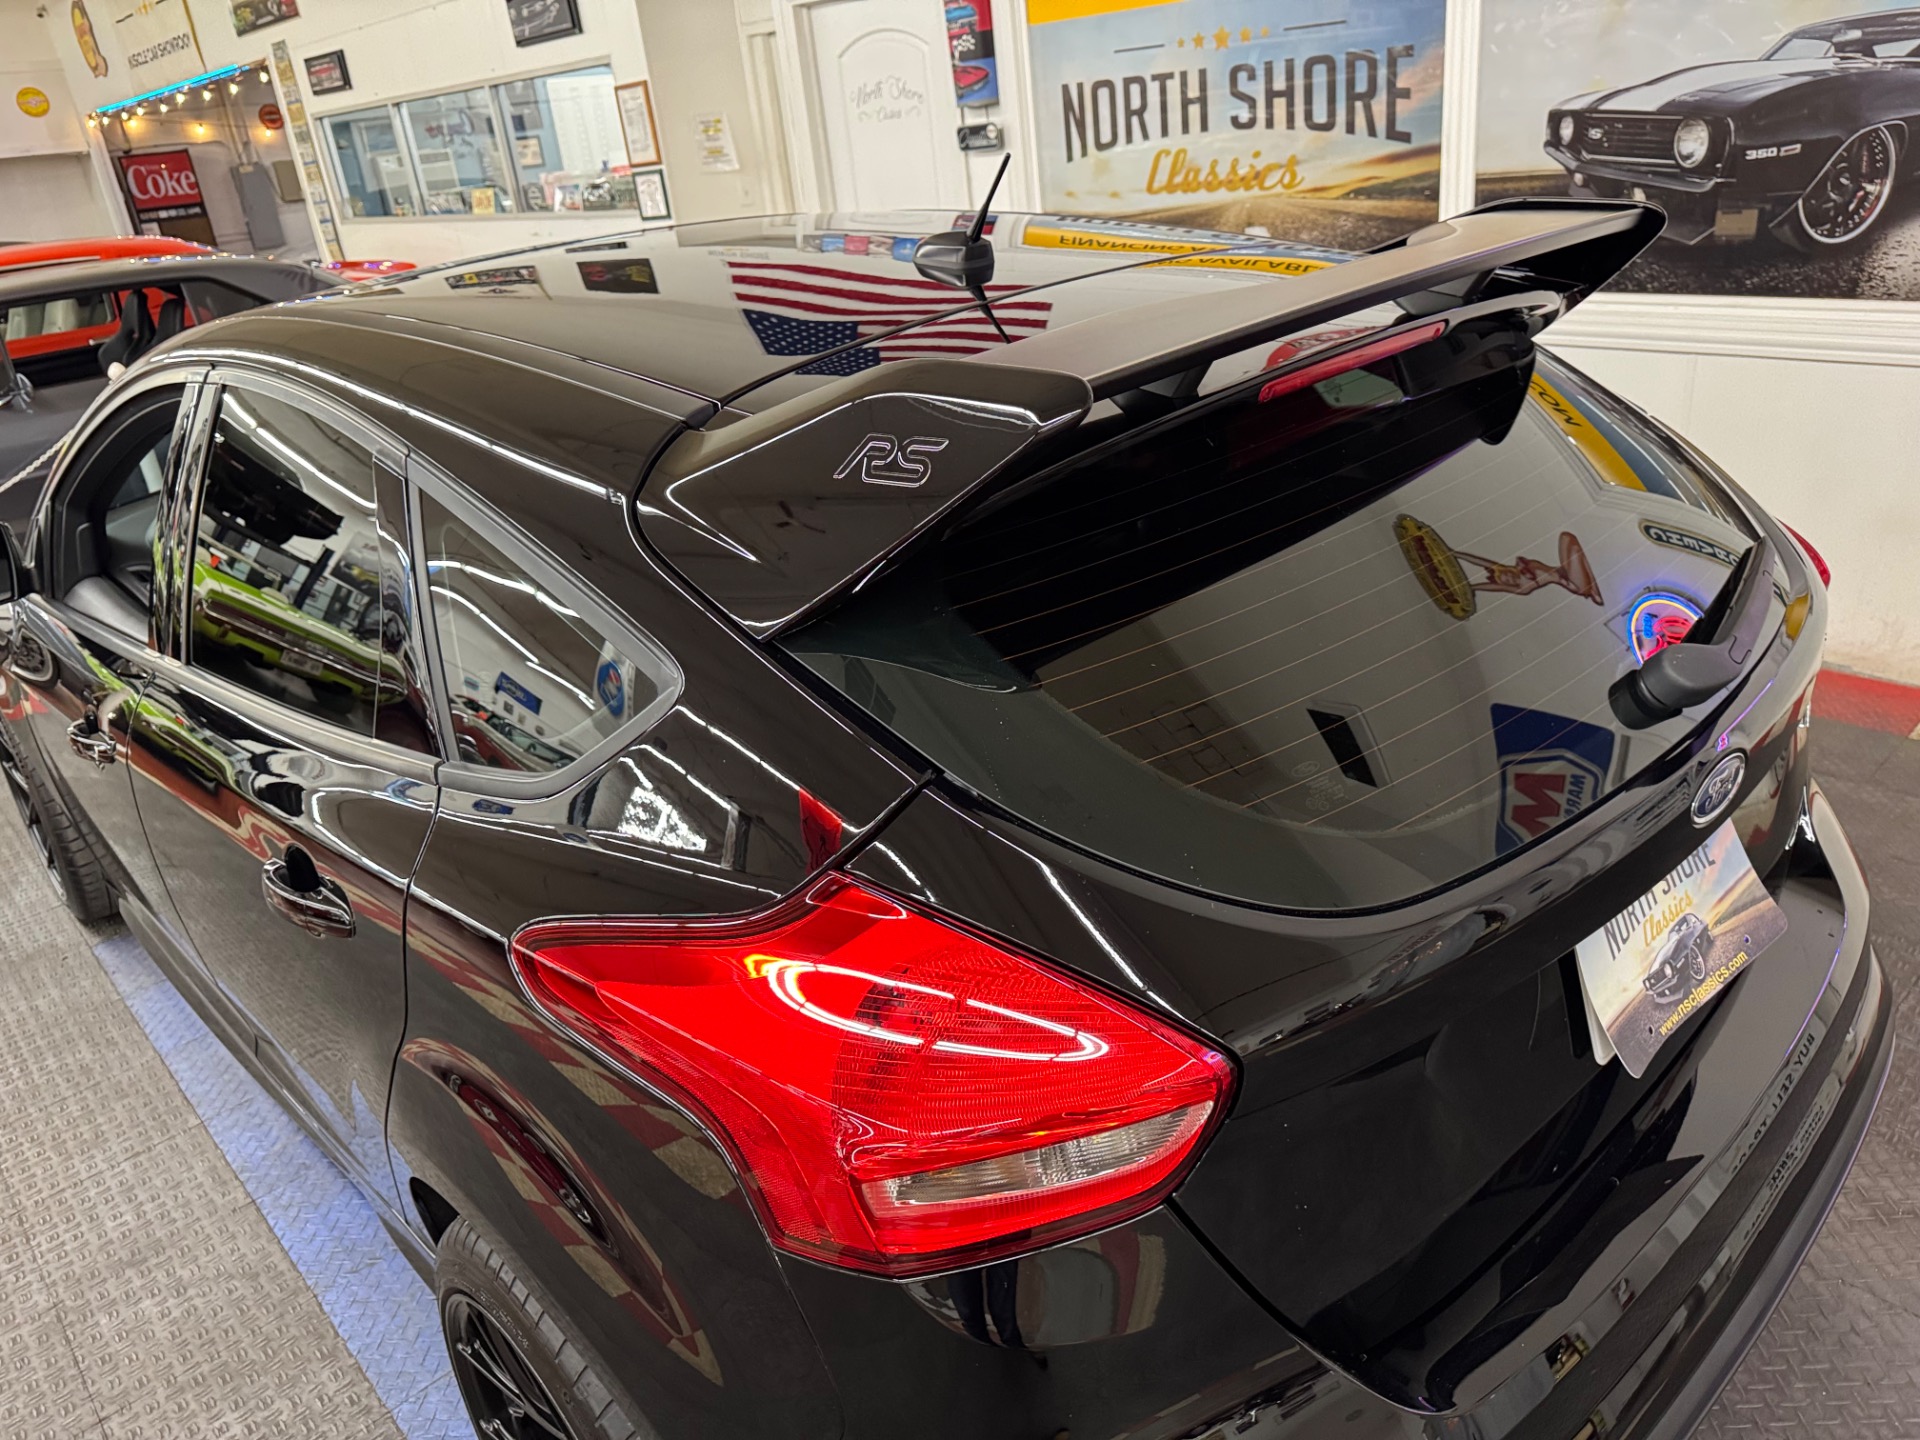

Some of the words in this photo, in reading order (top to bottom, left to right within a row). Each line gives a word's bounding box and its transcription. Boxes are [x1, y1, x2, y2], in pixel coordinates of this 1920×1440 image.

[1061, 67, 1209, 164] NORTH
[1228, 44, 1415, 145] SHORE
[1146, 148, 1305, 196] Classics
[1745, 146, 1778, 160] 350
[127, 164, 199, 200] Coke
[832, 432, 949, 488] RS
[1643, 888, 1694, 948] Classics
[1658, 950, 1749, 1037] www.nsclassics.com
